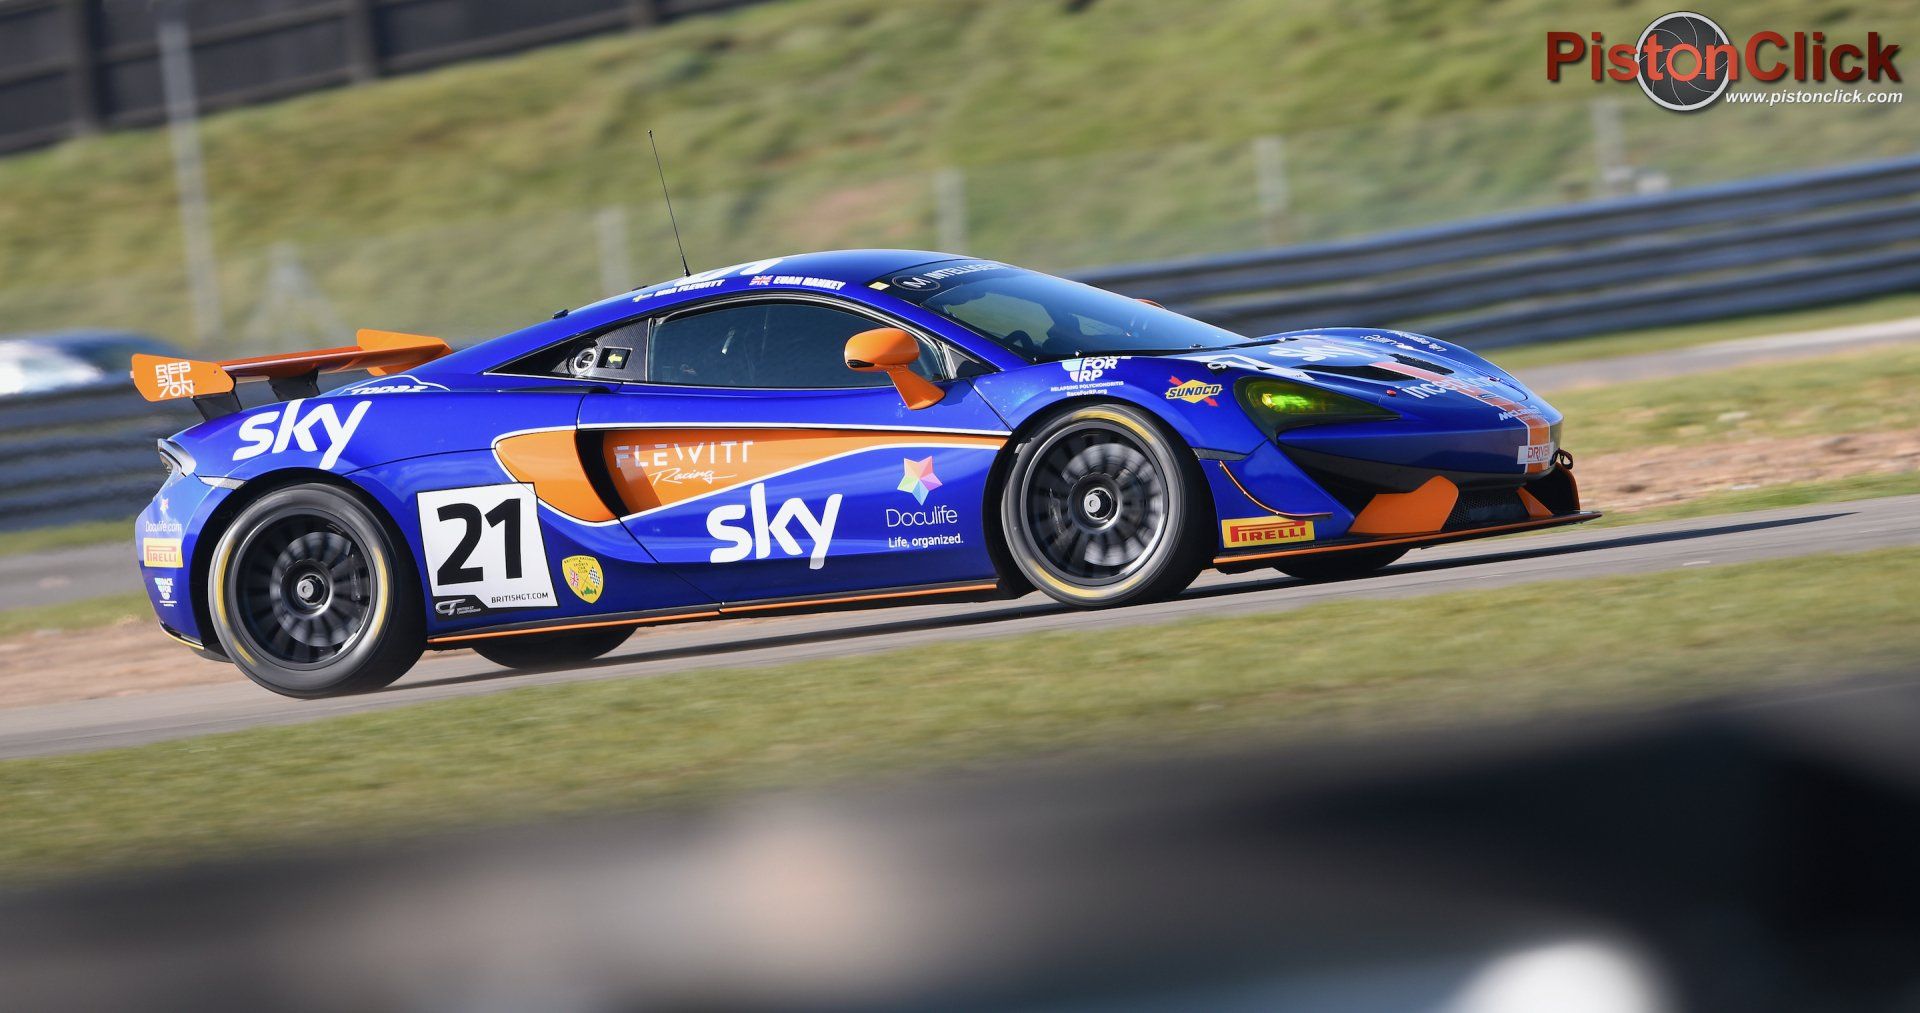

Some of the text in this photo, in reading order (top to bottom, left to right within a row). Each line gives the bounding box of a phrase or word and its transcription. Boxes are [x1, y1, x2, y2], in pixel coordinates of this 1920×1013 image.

[1081, 359, 1118, 371] FOR
[1079, 370, 1103, 382] RP
[1167, 384, 1220, 399] SUNOCO
[233, 398, 372, 470] sky
[614, 441, 753, 467] FLEWITT
[649, 468, 737, 486] Racing
[886, 505, 958, 528] Doculife
[706, 483, 843, 570] sky
[1230, 521, 1306, 543] PIRELLI
[437, 498, 522, 586] 21
[888, 533, 964, 548] Life, organized.
[147, 545, 177, 562] PIRELLI
[491, 592, 549, 604] BRITISHGT.COM
